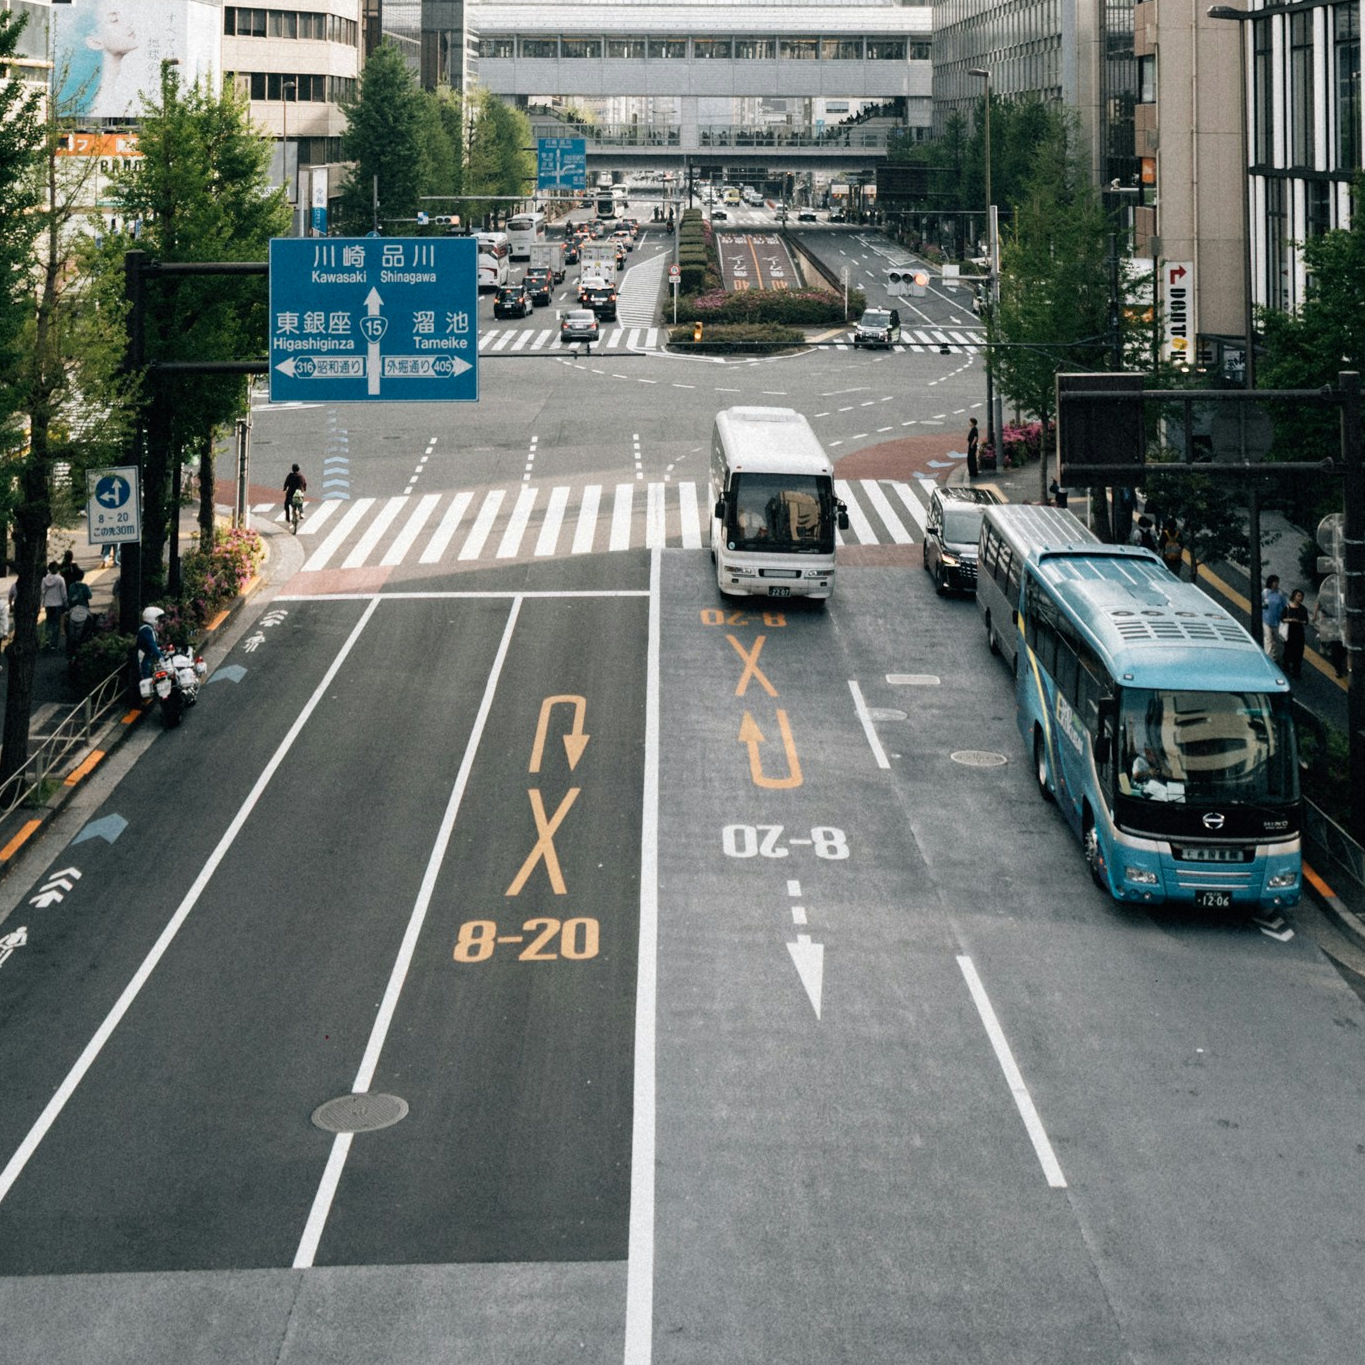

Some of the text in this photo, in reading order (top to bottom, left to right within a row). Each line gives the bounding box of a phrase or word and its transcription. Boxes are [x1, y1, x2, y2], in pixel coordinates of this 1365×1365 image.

[313, 244, 435, 268] 川崎 品川
[311, 270, 437, 285] Kawasaki Shinagawa
[275, 311, 353, 335] 東銀座
[365, 319, 383, 336] 15
[412, 311, 470, 335] 溜池
[273, 336, 355, 351] Higashiginza
[413, 336, 469, 350] Tameike
[296, 359, 361, 375] 316 昭和通り
[386, 359, 452, 375] 外堀通り 405
[93, 524, 135, 537] この先30m
[722, 824, 851, 861] 8-20
[453, 917, 600, 963] 8-20
